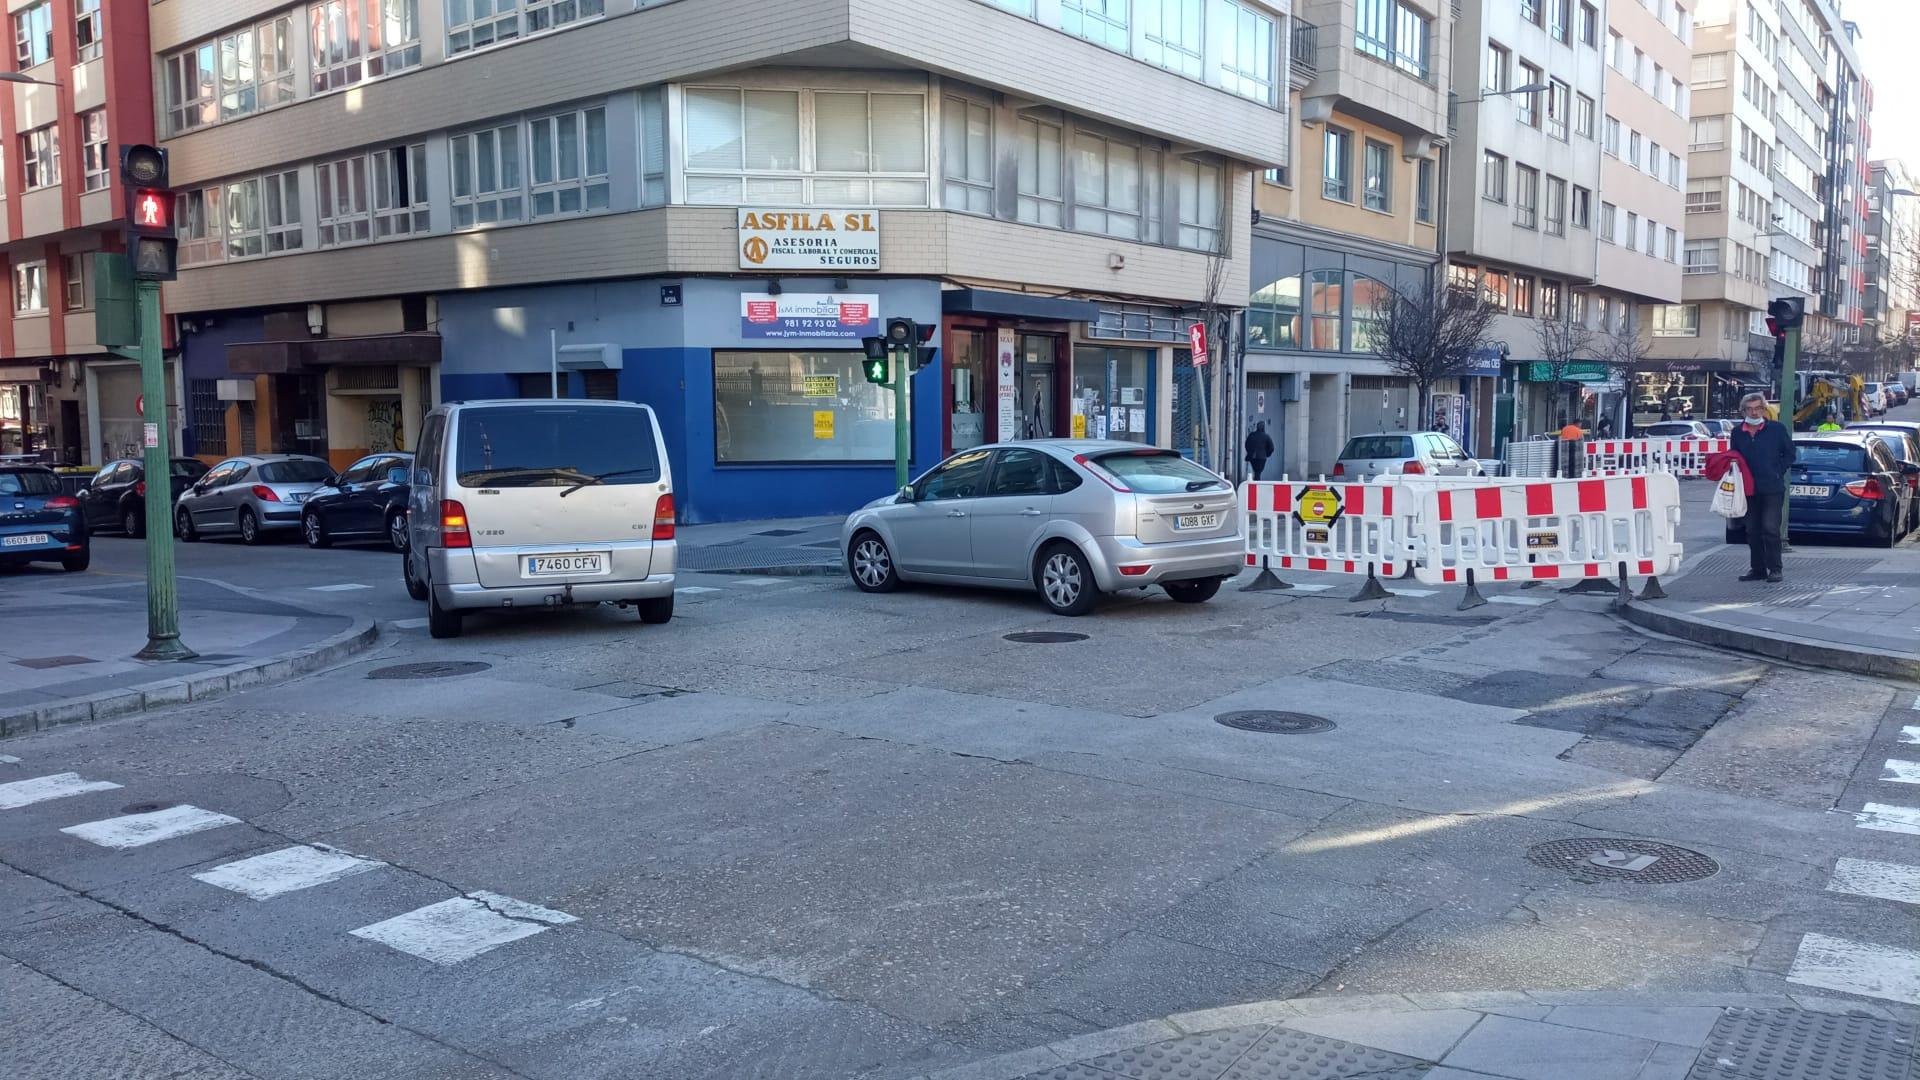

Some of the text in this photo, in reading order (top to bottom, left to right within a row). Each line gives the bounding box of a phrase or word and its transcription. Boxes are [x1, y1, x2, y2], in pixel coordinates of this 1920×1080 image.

[741, 212, 876, 231] ASFILA SL
[773, 238, 838, 247] ASESORIA
[820, 256, 877, 265] SEGUROS
[794, 305, 840, 314] inmobiliari
[784, 320, 837, 328] 981 92 93 02
[765, 330, 856, 338] www.jym-inmobiliaria.com
[1790, 486, 1828, 495] 751 DZP
[1180, 515, 1215, 527] 4088 GXF
[6, 536, 28, 545] 6609
[538, 557, 598, 571] 7460 CFV
